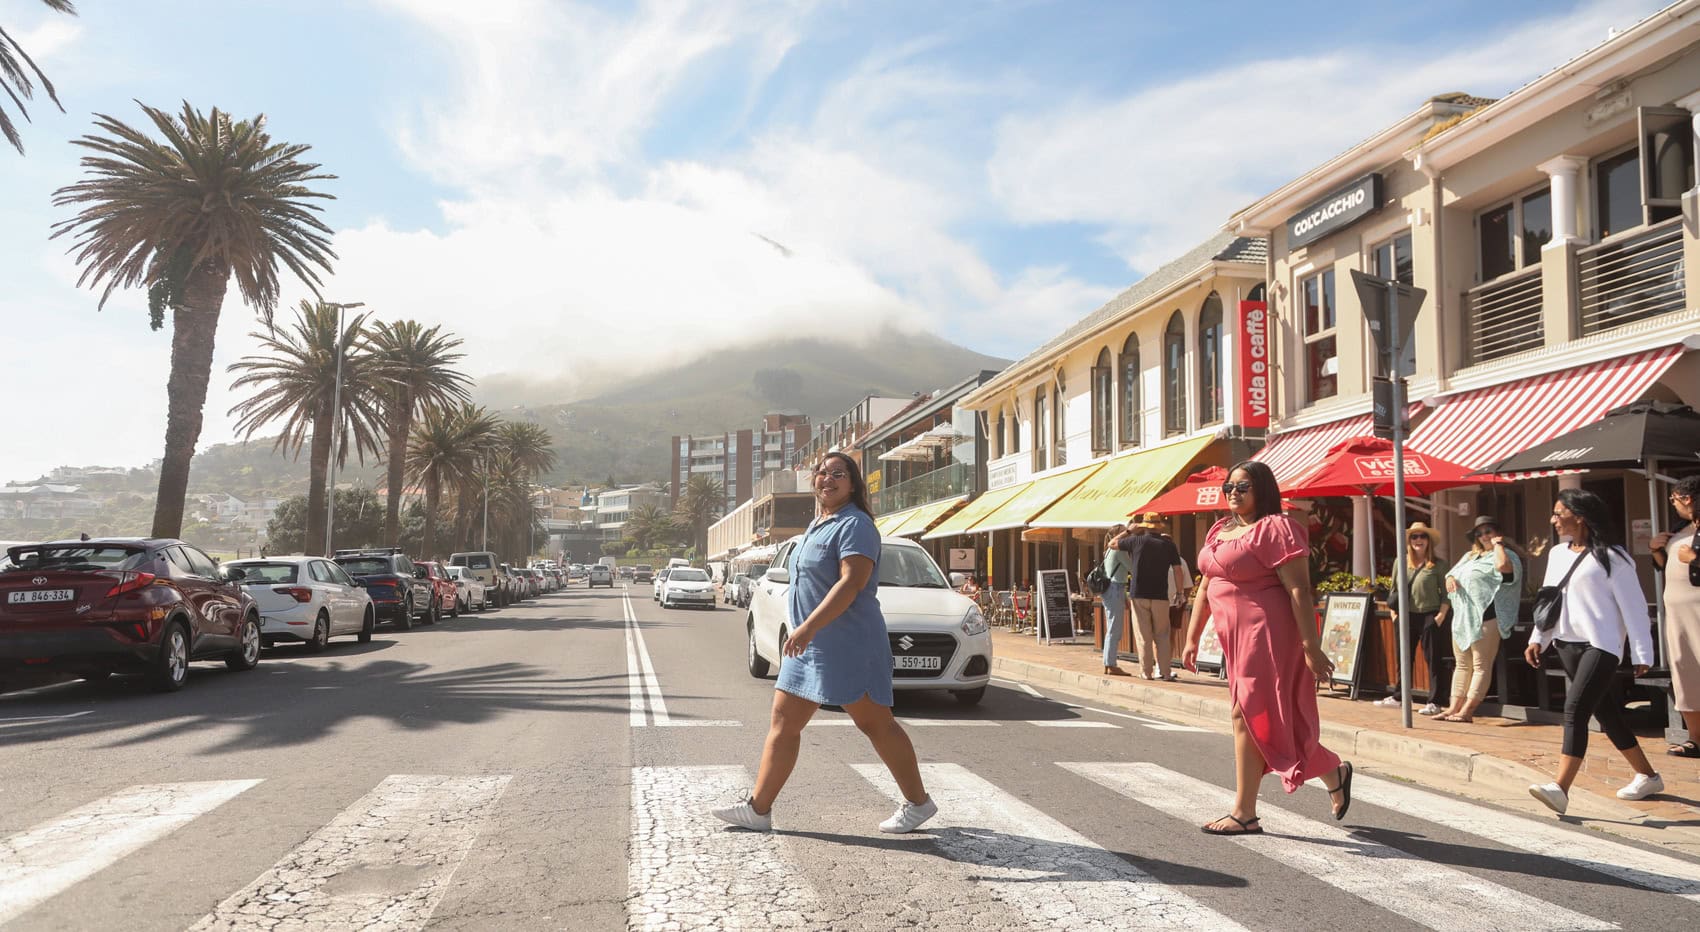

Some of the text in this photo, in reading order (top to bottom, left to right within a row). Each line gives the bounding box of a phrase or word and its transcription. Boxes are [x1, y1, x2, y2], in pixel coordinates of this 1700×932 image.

[1246, 308, 1266, 417] vida e caffè
[13, 590, 69, 602] CA 846-334
[1333, 601, 1362, 610] WINTER
[902, 657, 938, 668] 559-110
